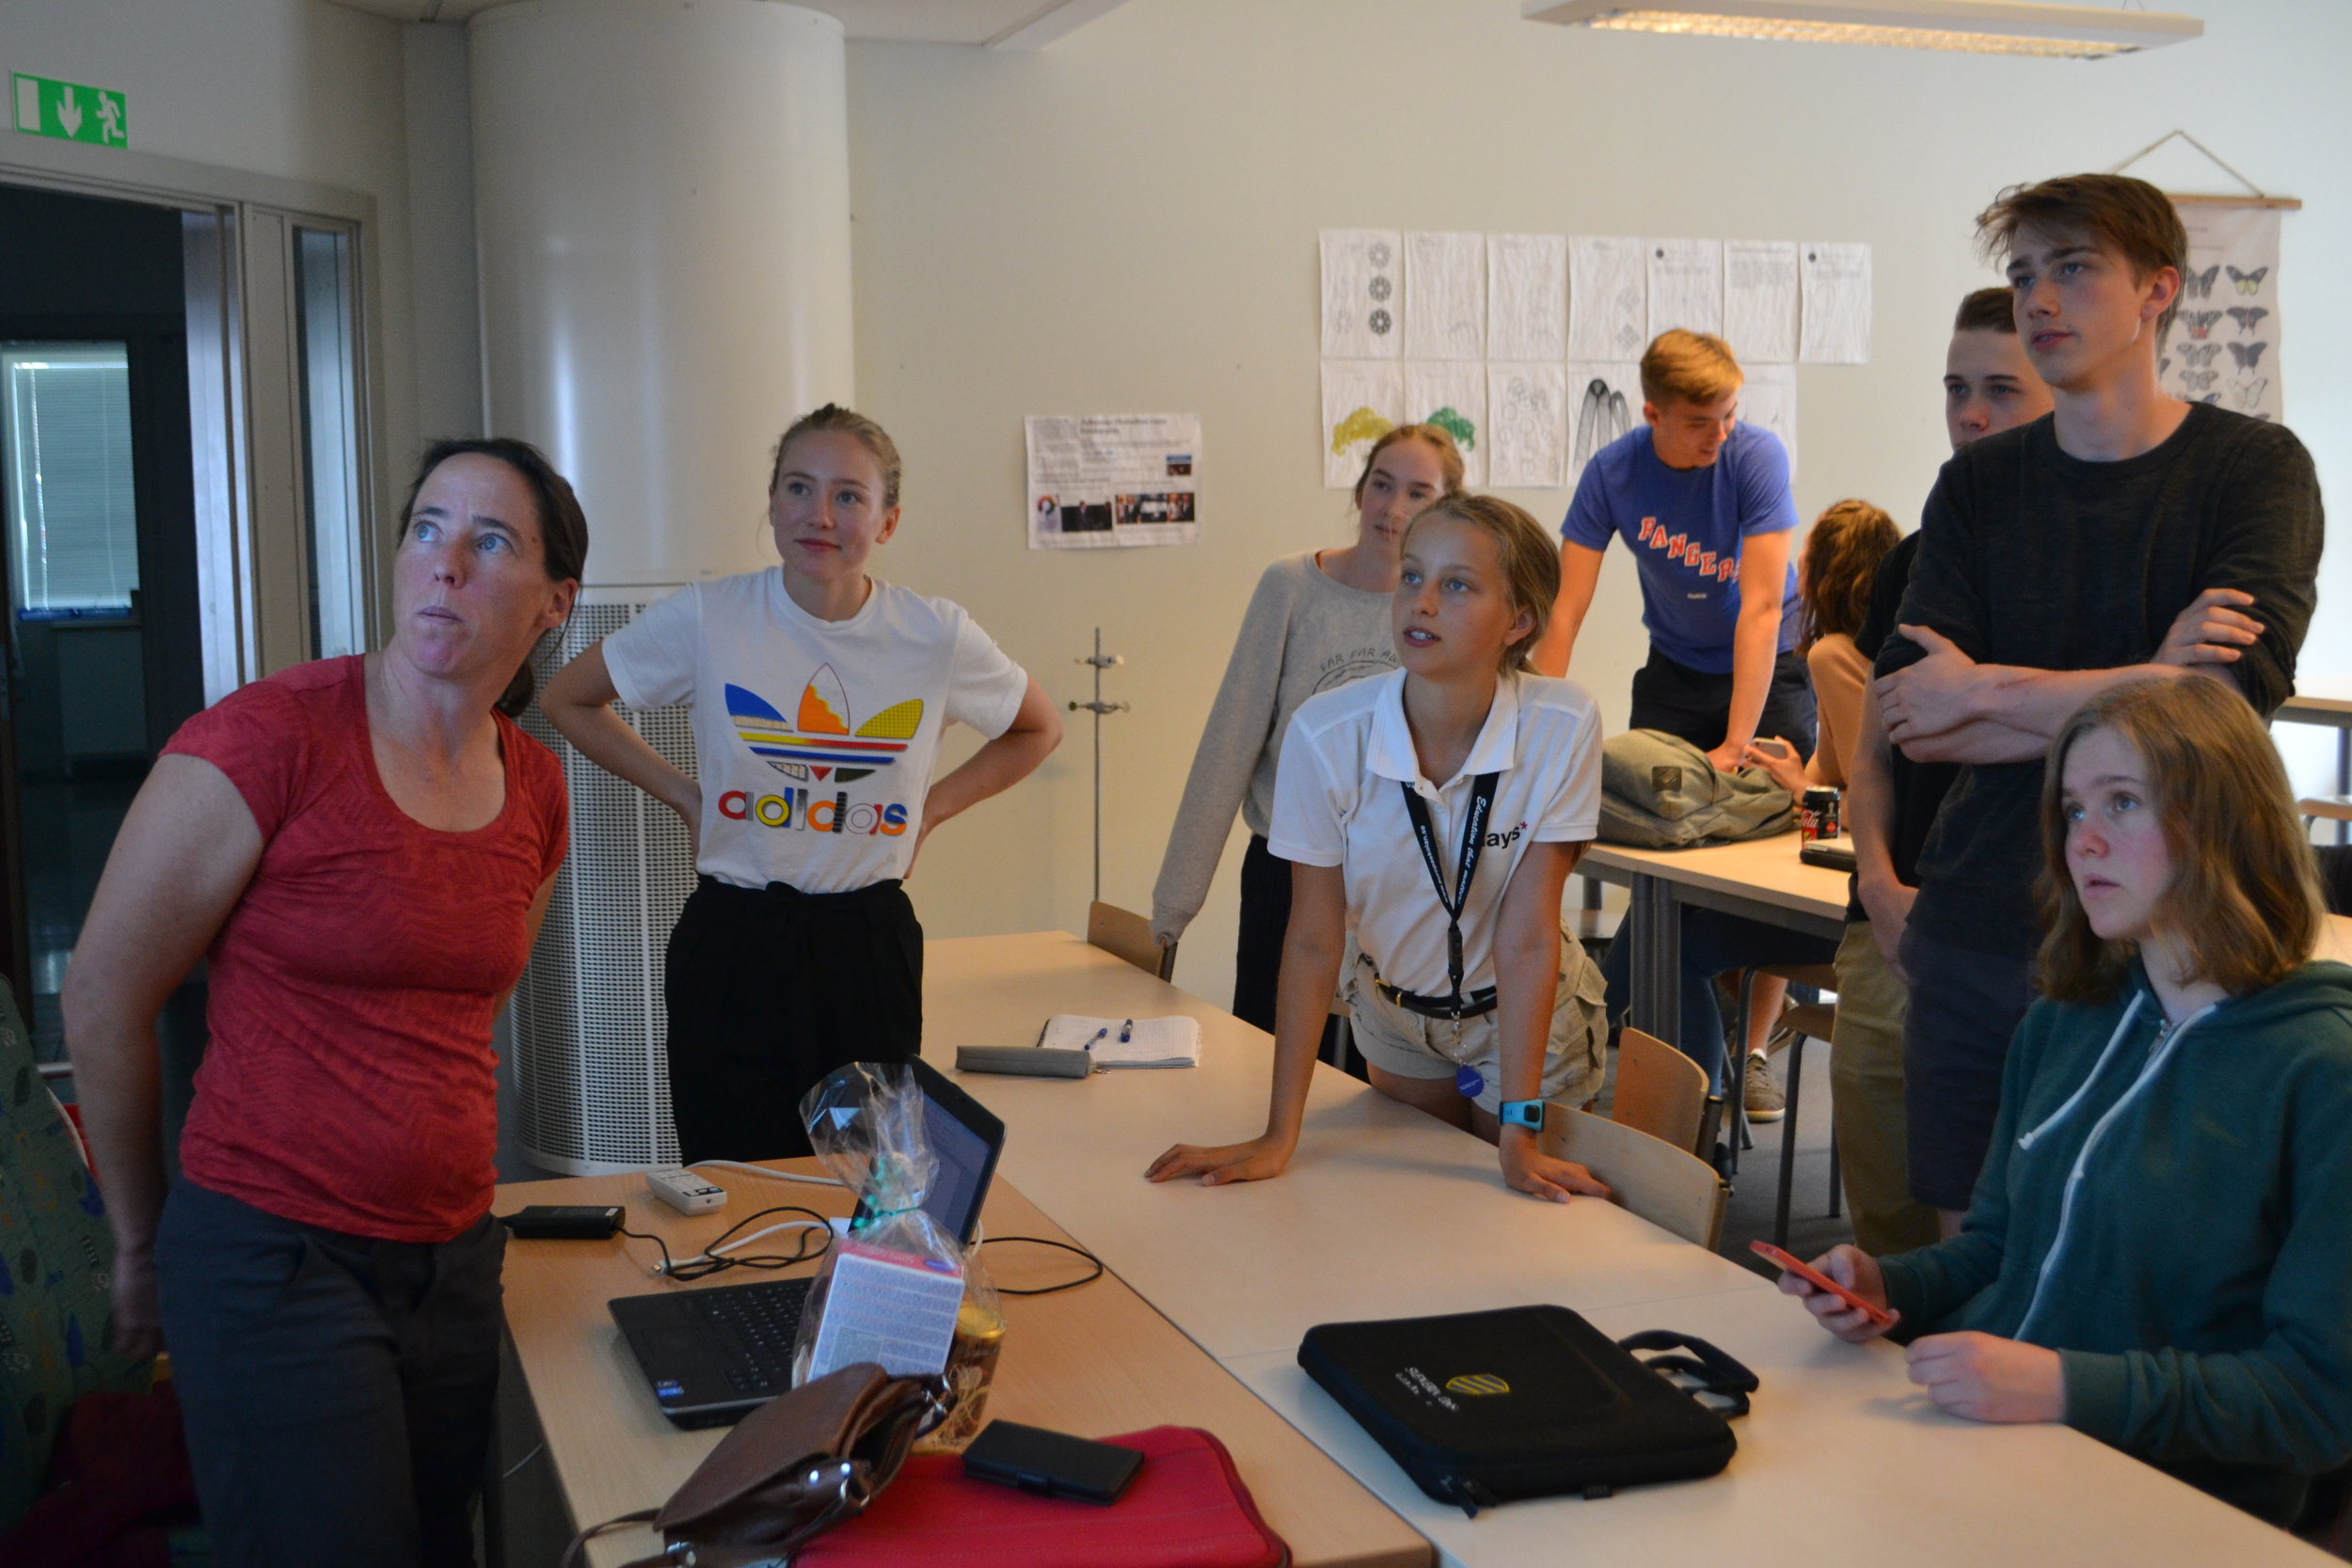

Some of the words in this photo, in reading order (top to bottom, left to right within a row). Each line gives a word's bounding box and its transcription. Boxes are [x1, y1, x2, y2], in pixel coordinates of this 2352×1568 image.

[718, 786, 908, 836] adidas
[1469, 795, 1486, 845] Education
[1484, 821, 1527, 849] ays
[1465, 847, 1474, 868] that
